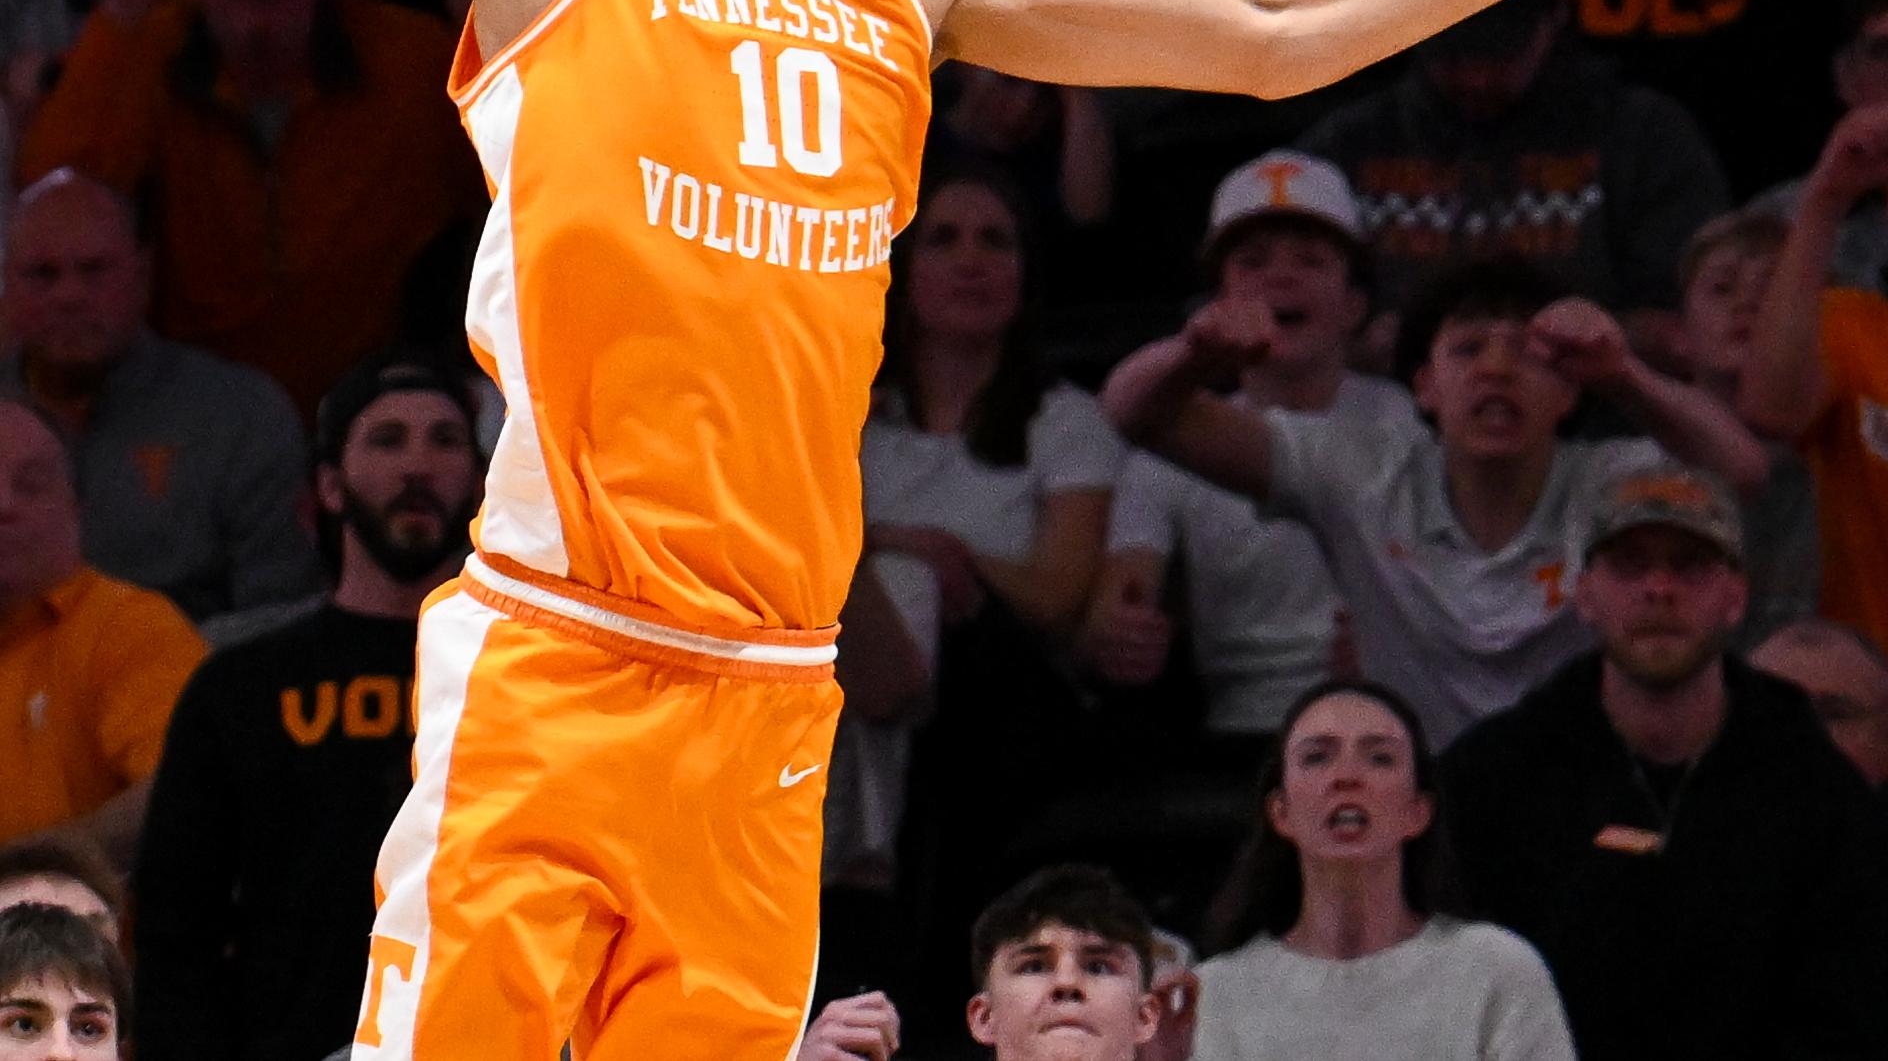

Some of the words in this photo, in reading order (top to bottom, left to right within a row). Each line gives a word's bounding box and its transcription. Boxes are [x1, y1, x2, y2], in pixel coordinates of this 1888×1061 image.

[730, 40, 842, 178] 10
[638, 156, 896, 274] VOLUNTEERS
[1256, 163, 1305, 207] T
[278, 674, 415, 748] VO
